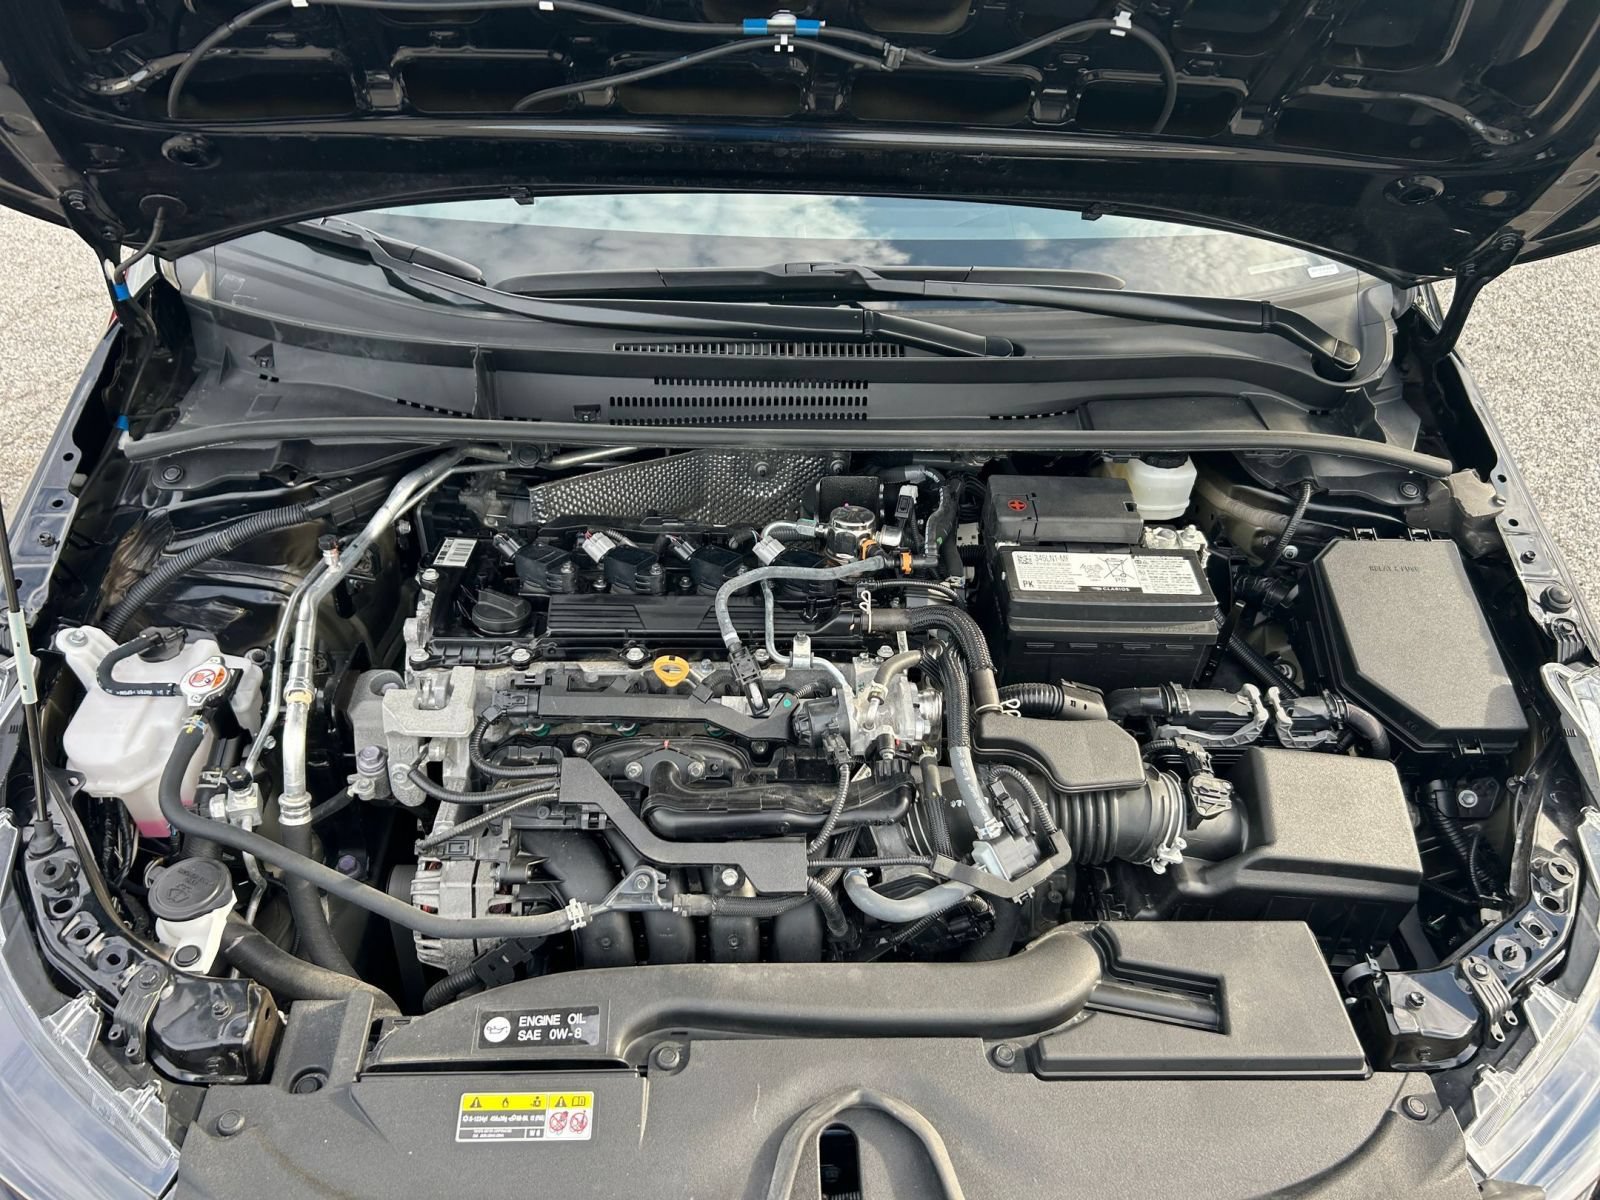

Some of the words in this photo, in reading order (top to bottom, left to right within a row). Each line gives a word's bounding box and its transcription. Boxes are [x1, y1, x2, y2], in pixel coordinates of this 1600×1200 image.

[1023, 579, 1034, 588] PK
[518, 1014, 561, 1027] ENGINE
[567, 1012, 586, 1025] OIL
[517, 1029, 542, 1041] SAE
[549, 1027, 582, 1040] 0W-8
